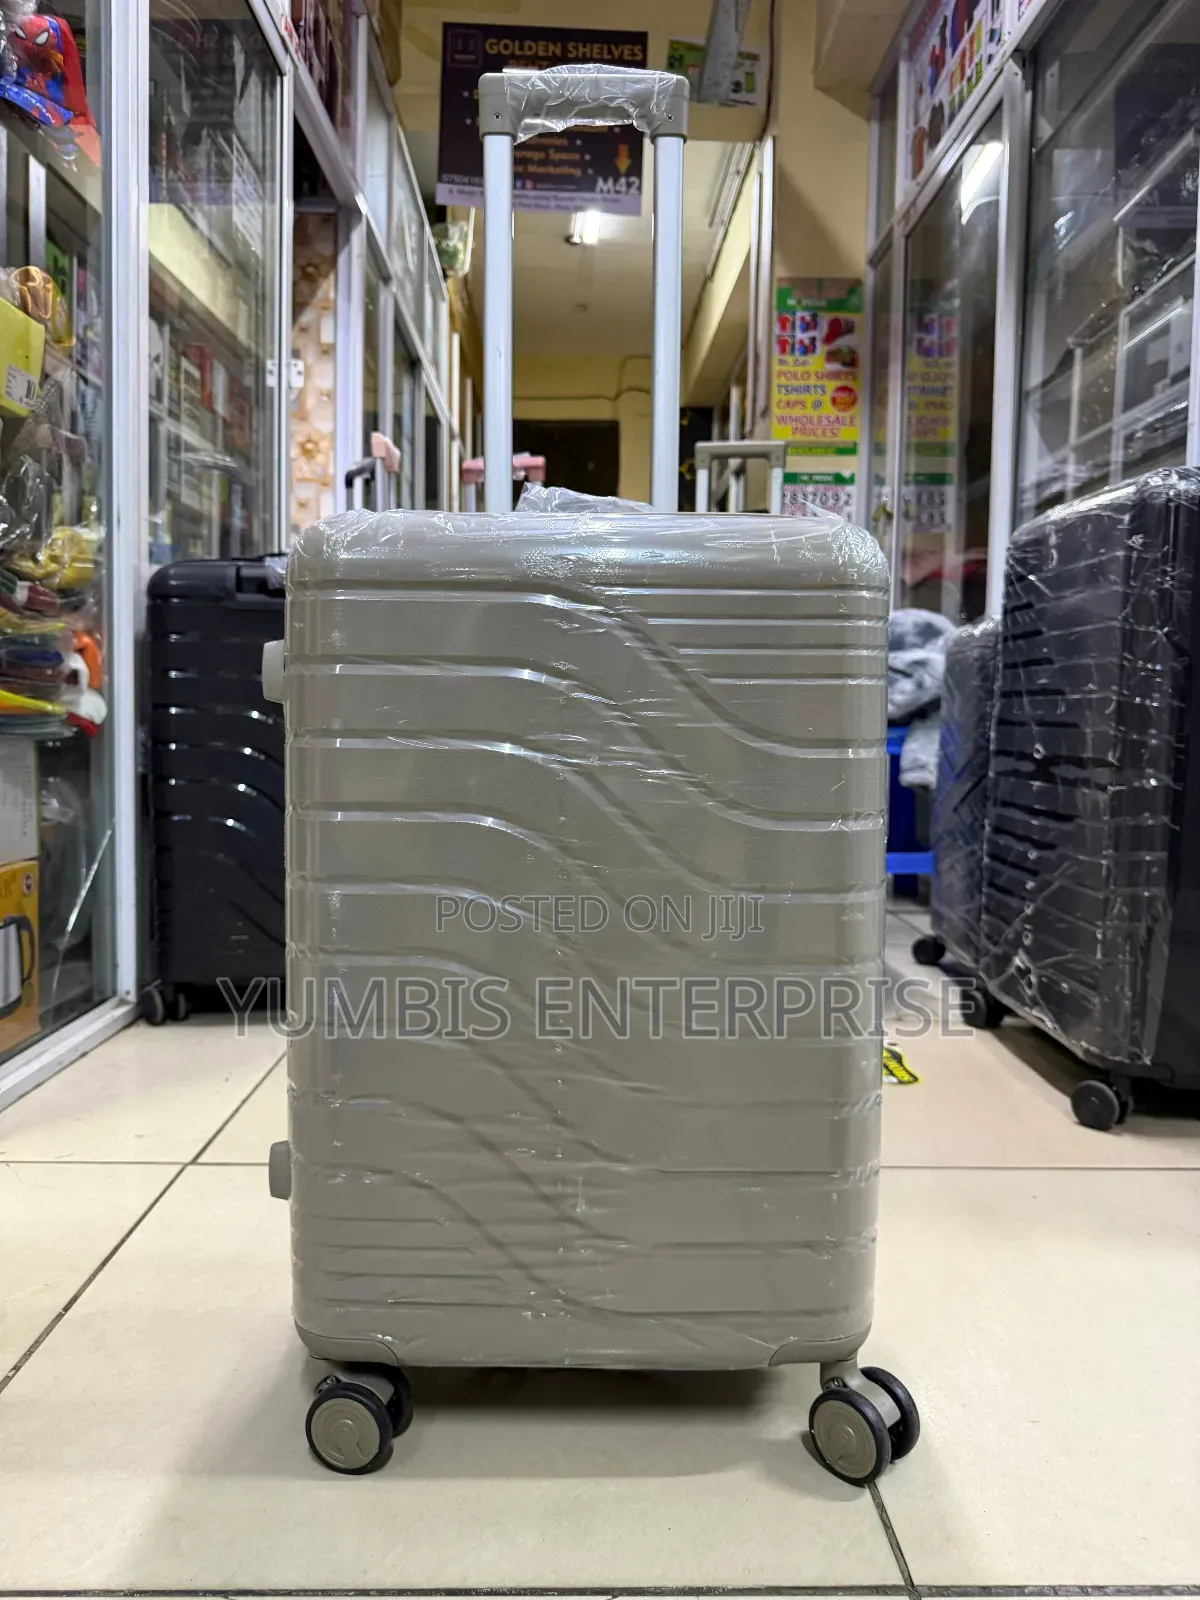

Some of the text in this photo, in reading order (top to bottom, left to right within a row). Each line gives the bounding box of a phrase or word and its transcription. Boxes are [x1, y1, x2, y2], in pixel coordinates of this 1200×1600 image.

[484, 38, 644, 60] GOLDEN SHELVES
[595, 176, 641, 194] M42
[776, 370, 812, 382] POLO
[776, 384, 827, 396] TSHIRTS
[776, 415, 857, 427] WHOLESALE
